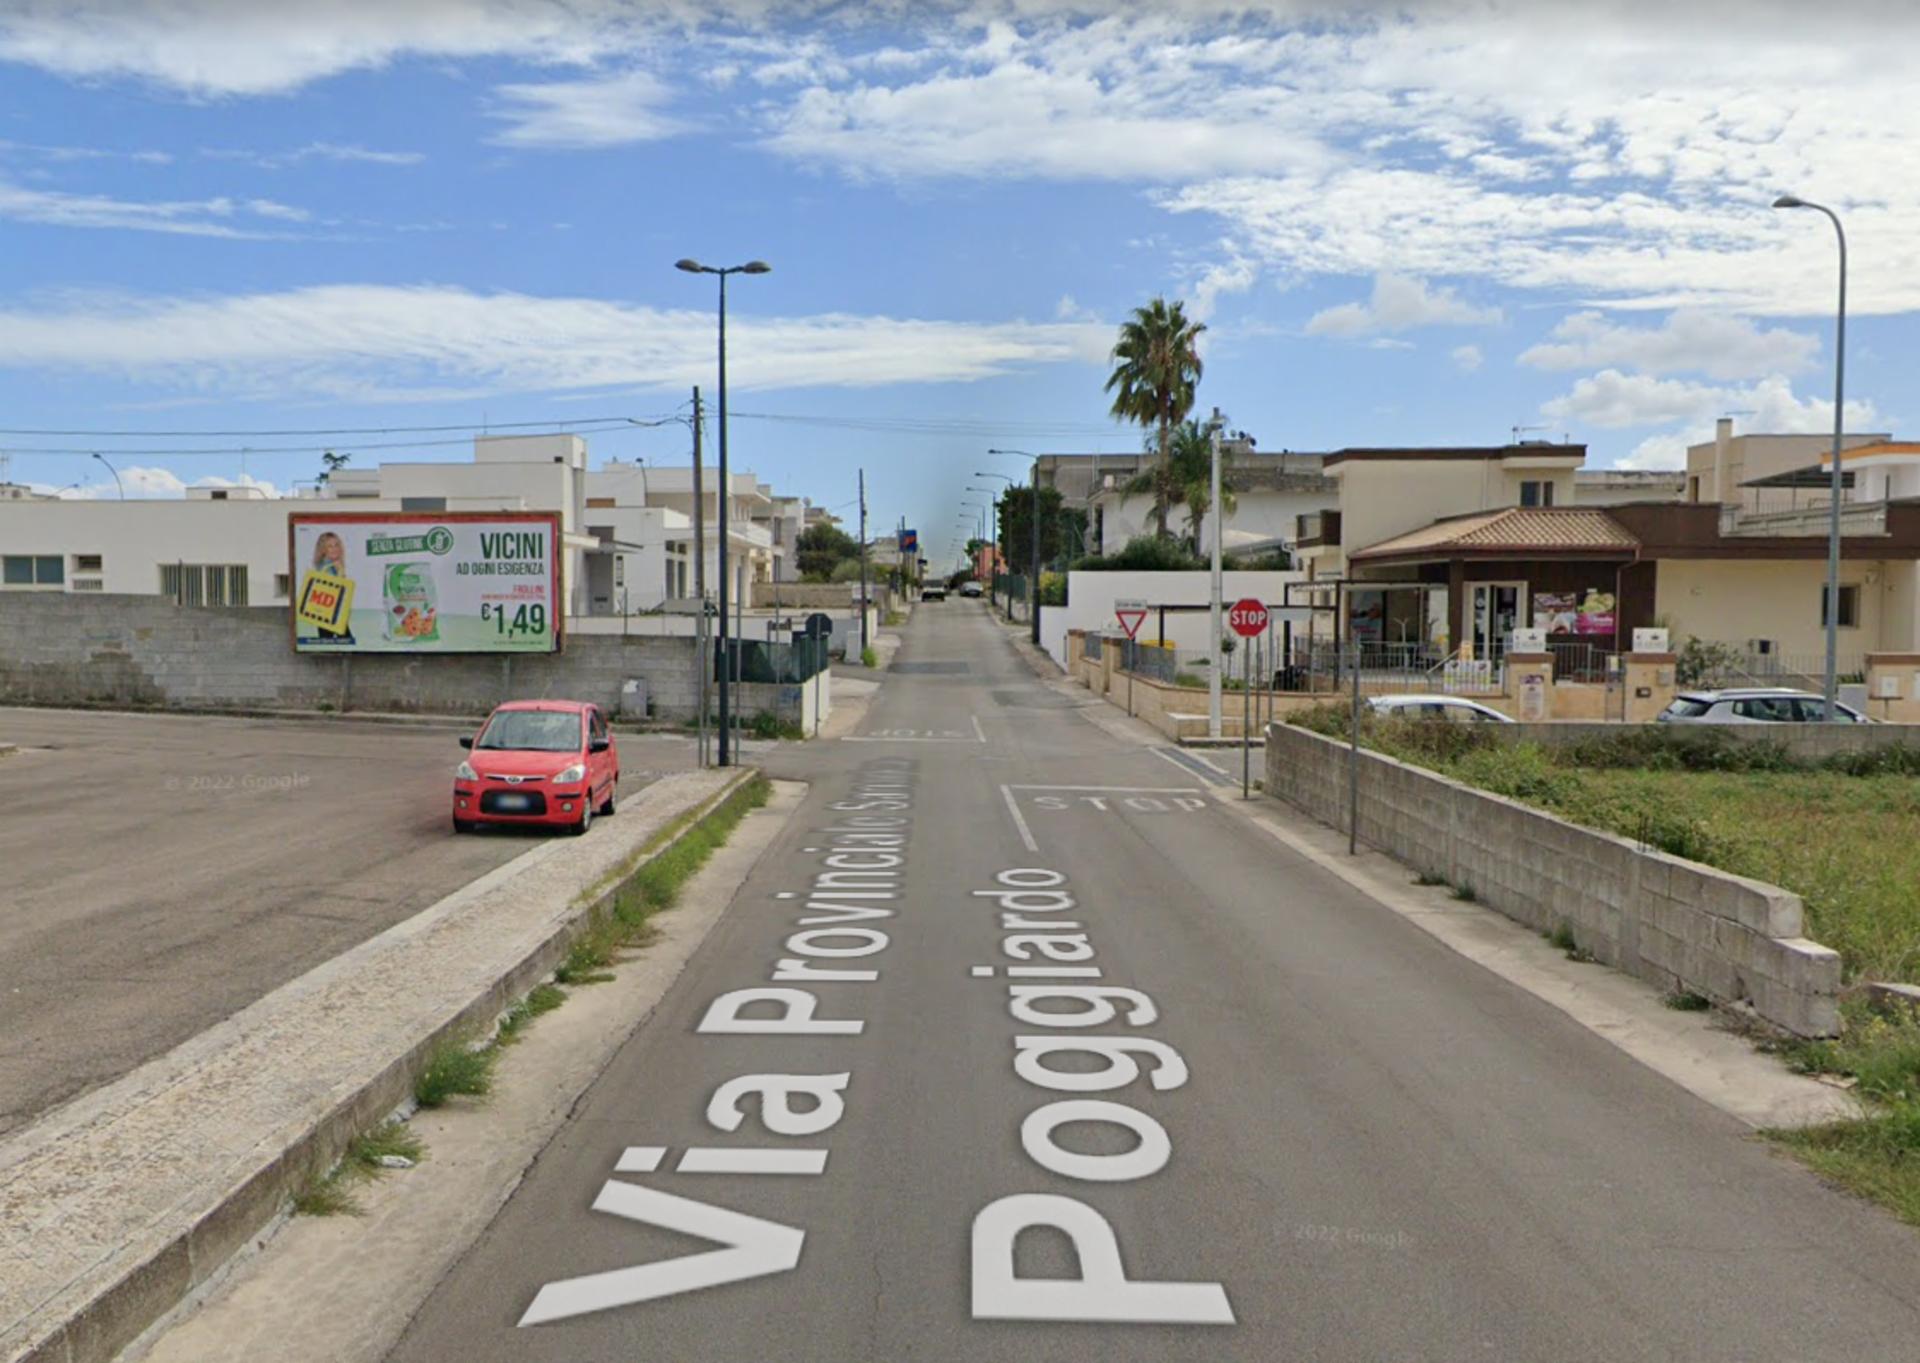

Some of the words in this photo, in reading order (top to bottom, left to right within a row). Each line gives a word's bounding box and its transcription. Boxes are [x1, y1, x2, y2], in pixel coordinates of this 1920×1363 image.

[480, 532, 543, 559] VICINI
[456, 562, 469, 575] AD
[471, 562, 496, 575] OGNI
[497, 562, 544, 575] ESIGENZA
[311, 589, 338, 609] MD
[1232, 610, 1266, 625] STOP
[1031, 796, 1206, 812] STOP
